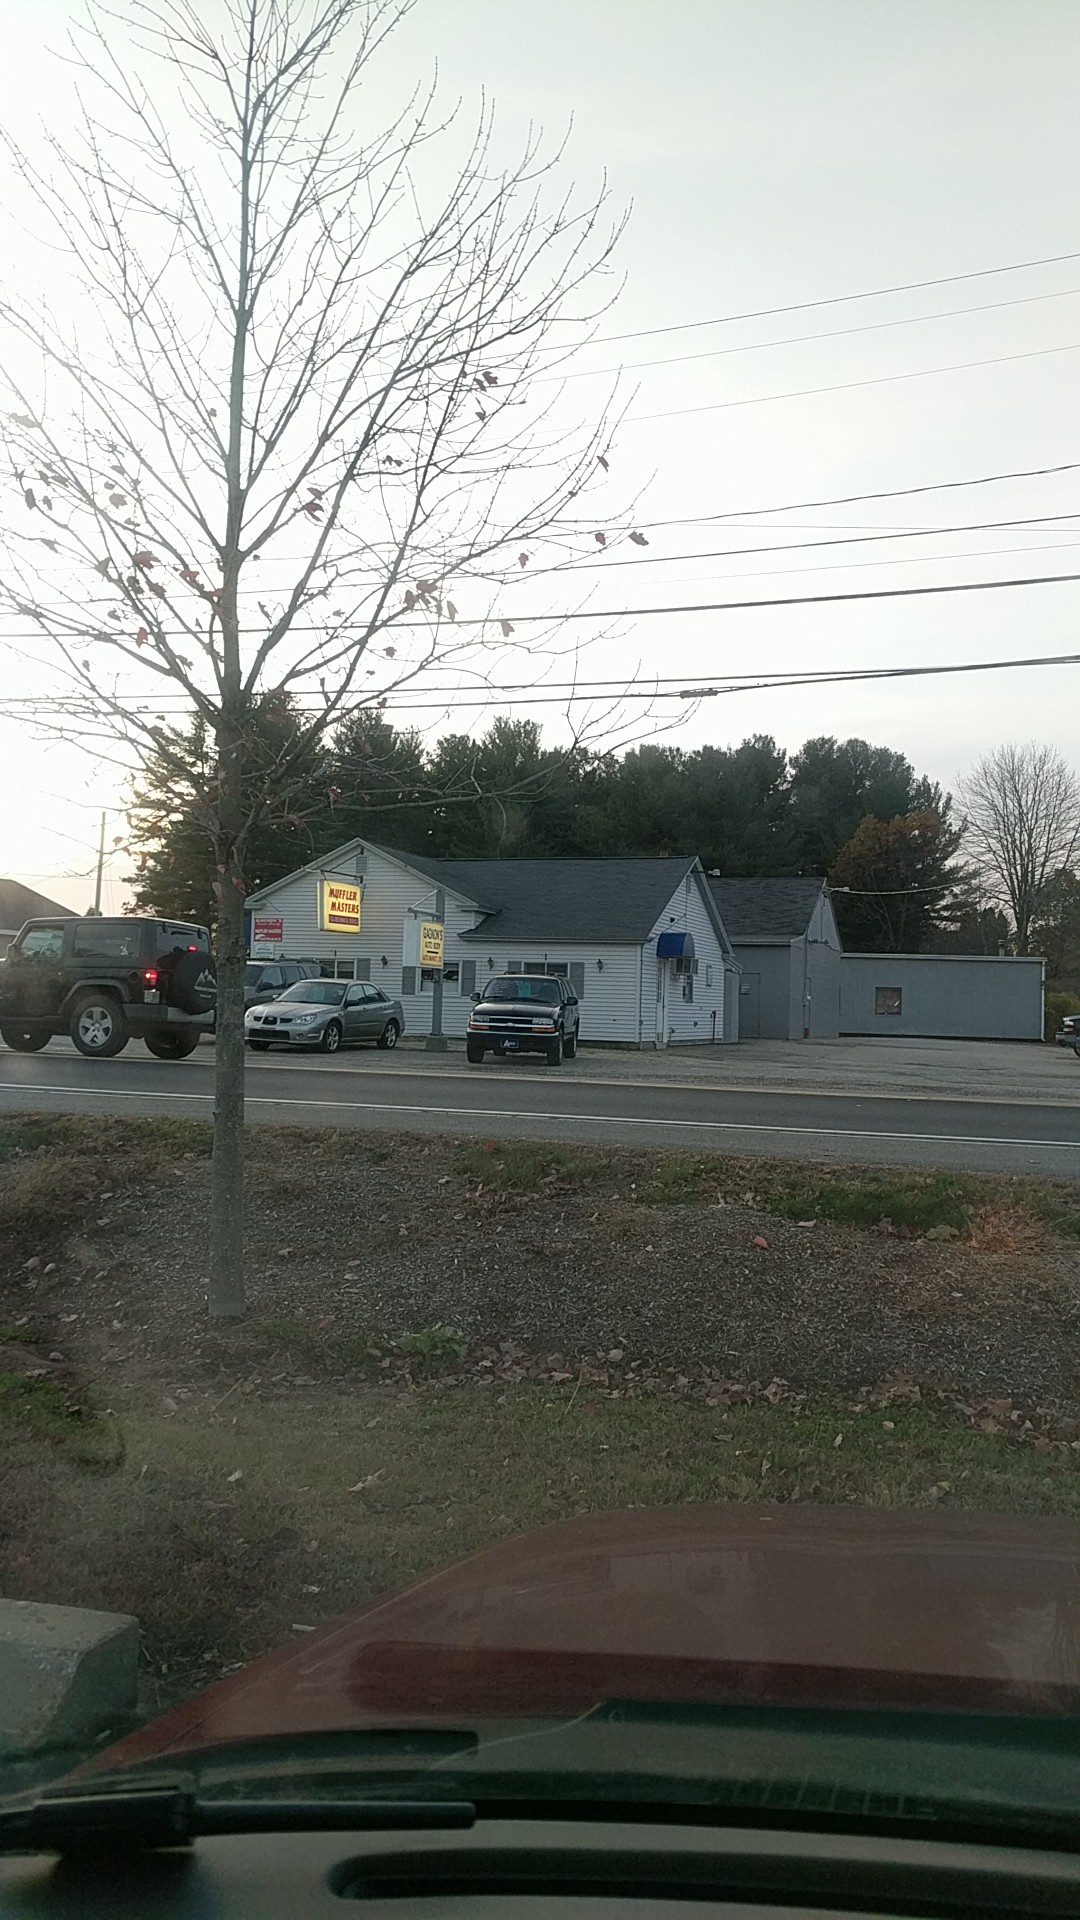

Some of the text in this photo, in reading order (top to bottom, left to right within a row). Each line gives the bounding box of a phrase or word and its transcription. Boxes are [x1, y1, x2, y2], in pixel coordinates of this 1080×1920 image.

[328, 888, 357, 901] MUFFLER
[330, 901, 359, 914] MASTERS
[423, 927, 443, 941] GAGNON'S
[425, 941, 441, 950] AUTO BODY
